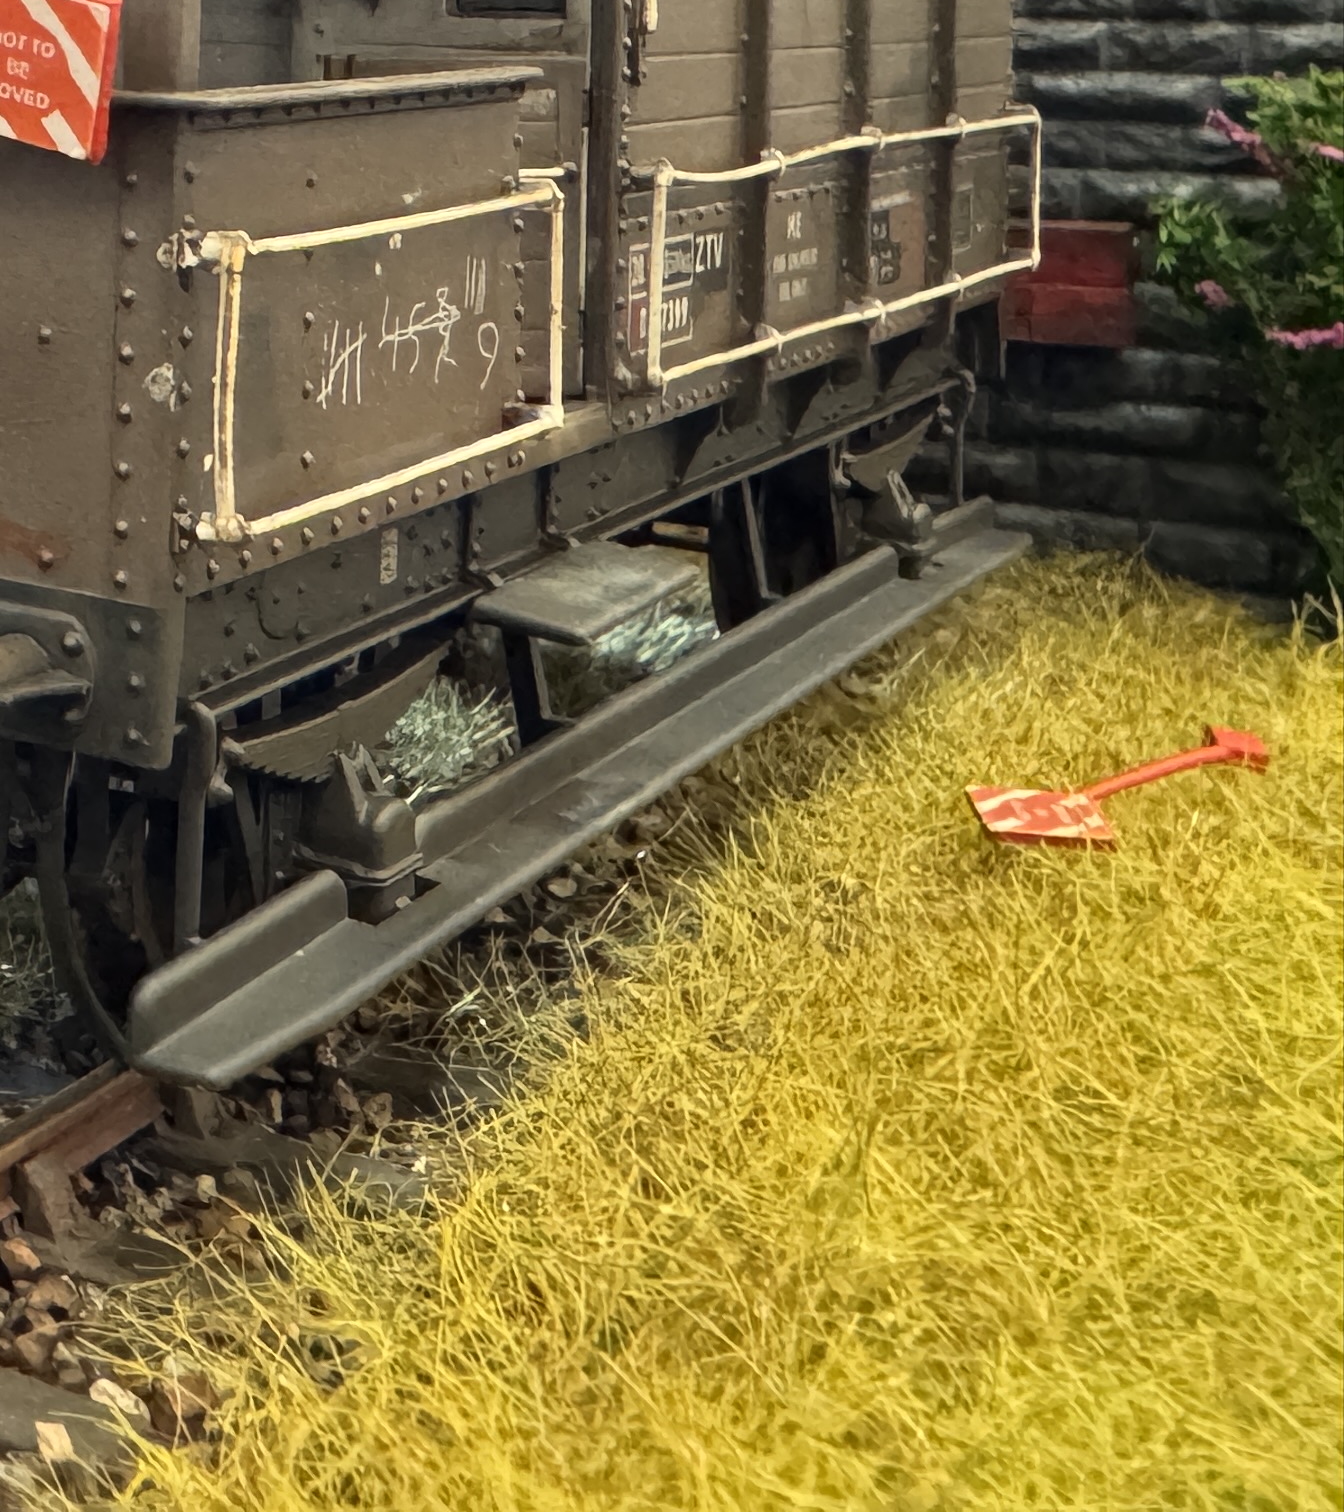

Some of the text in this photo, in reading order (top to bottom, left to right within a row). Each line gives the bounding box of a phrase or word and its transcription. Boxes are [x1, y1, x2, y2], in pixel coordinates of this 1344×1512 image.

[32, 38, 56, 58] TO
[7, 57, 29, 79] BE
[695, 232, 724, 273] ZTV
